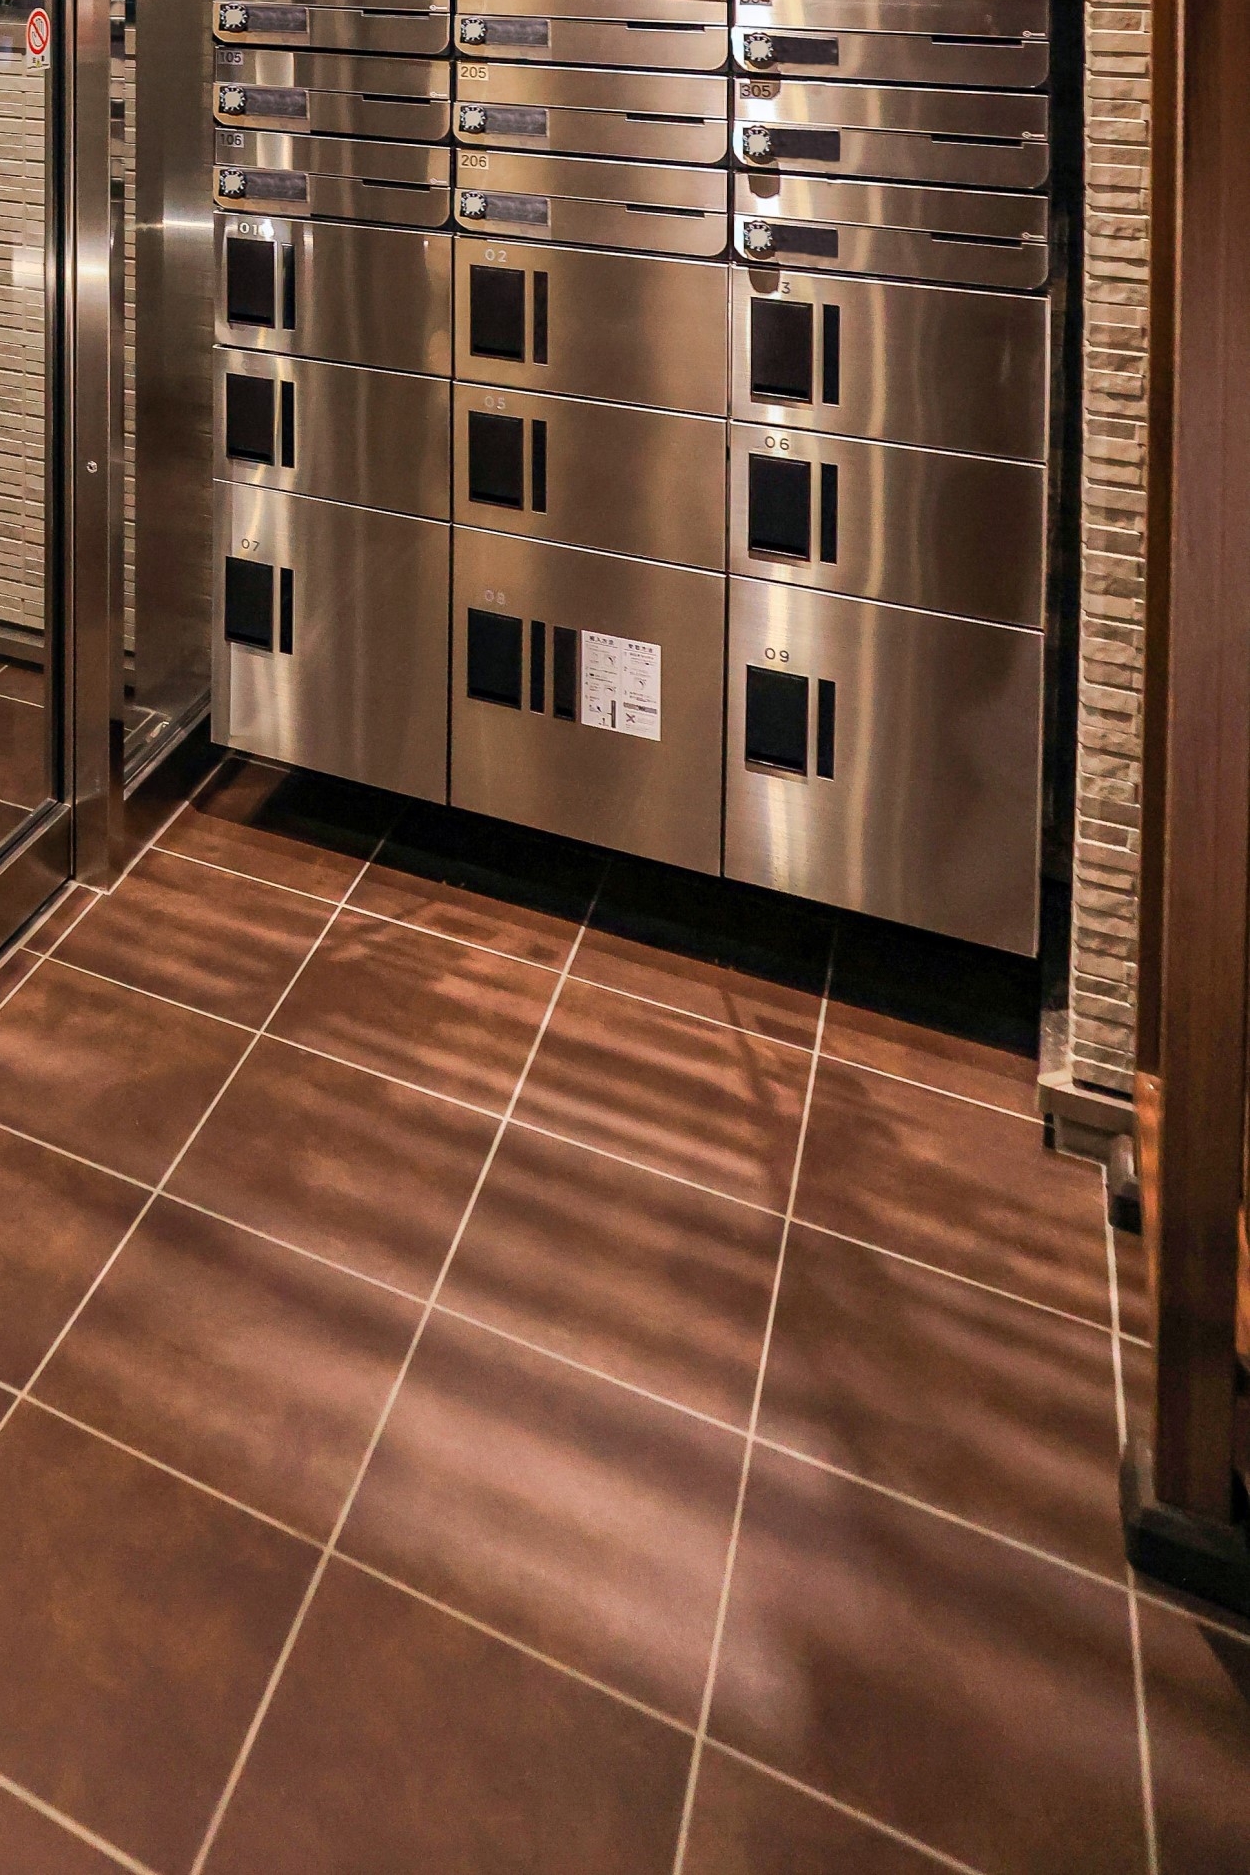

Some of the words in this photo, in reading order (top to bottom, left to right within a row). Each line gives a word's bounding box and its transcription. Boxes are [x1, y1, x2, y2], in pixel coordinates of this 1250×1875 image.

[220, 52, 242, 63] 105
[461, 67, 487, 78] 205
[740, 84, 771, 97] 305
[220, 134, 242, 146] 106
[461, 155, 487, 167] 206
[485, 249, 507, 263] 02
[485, 396, 506, 411] 05
[765, 436, 790, 451] 06
[241, 538, 260, 552] 07
[765, 648, 790, 663] 09
